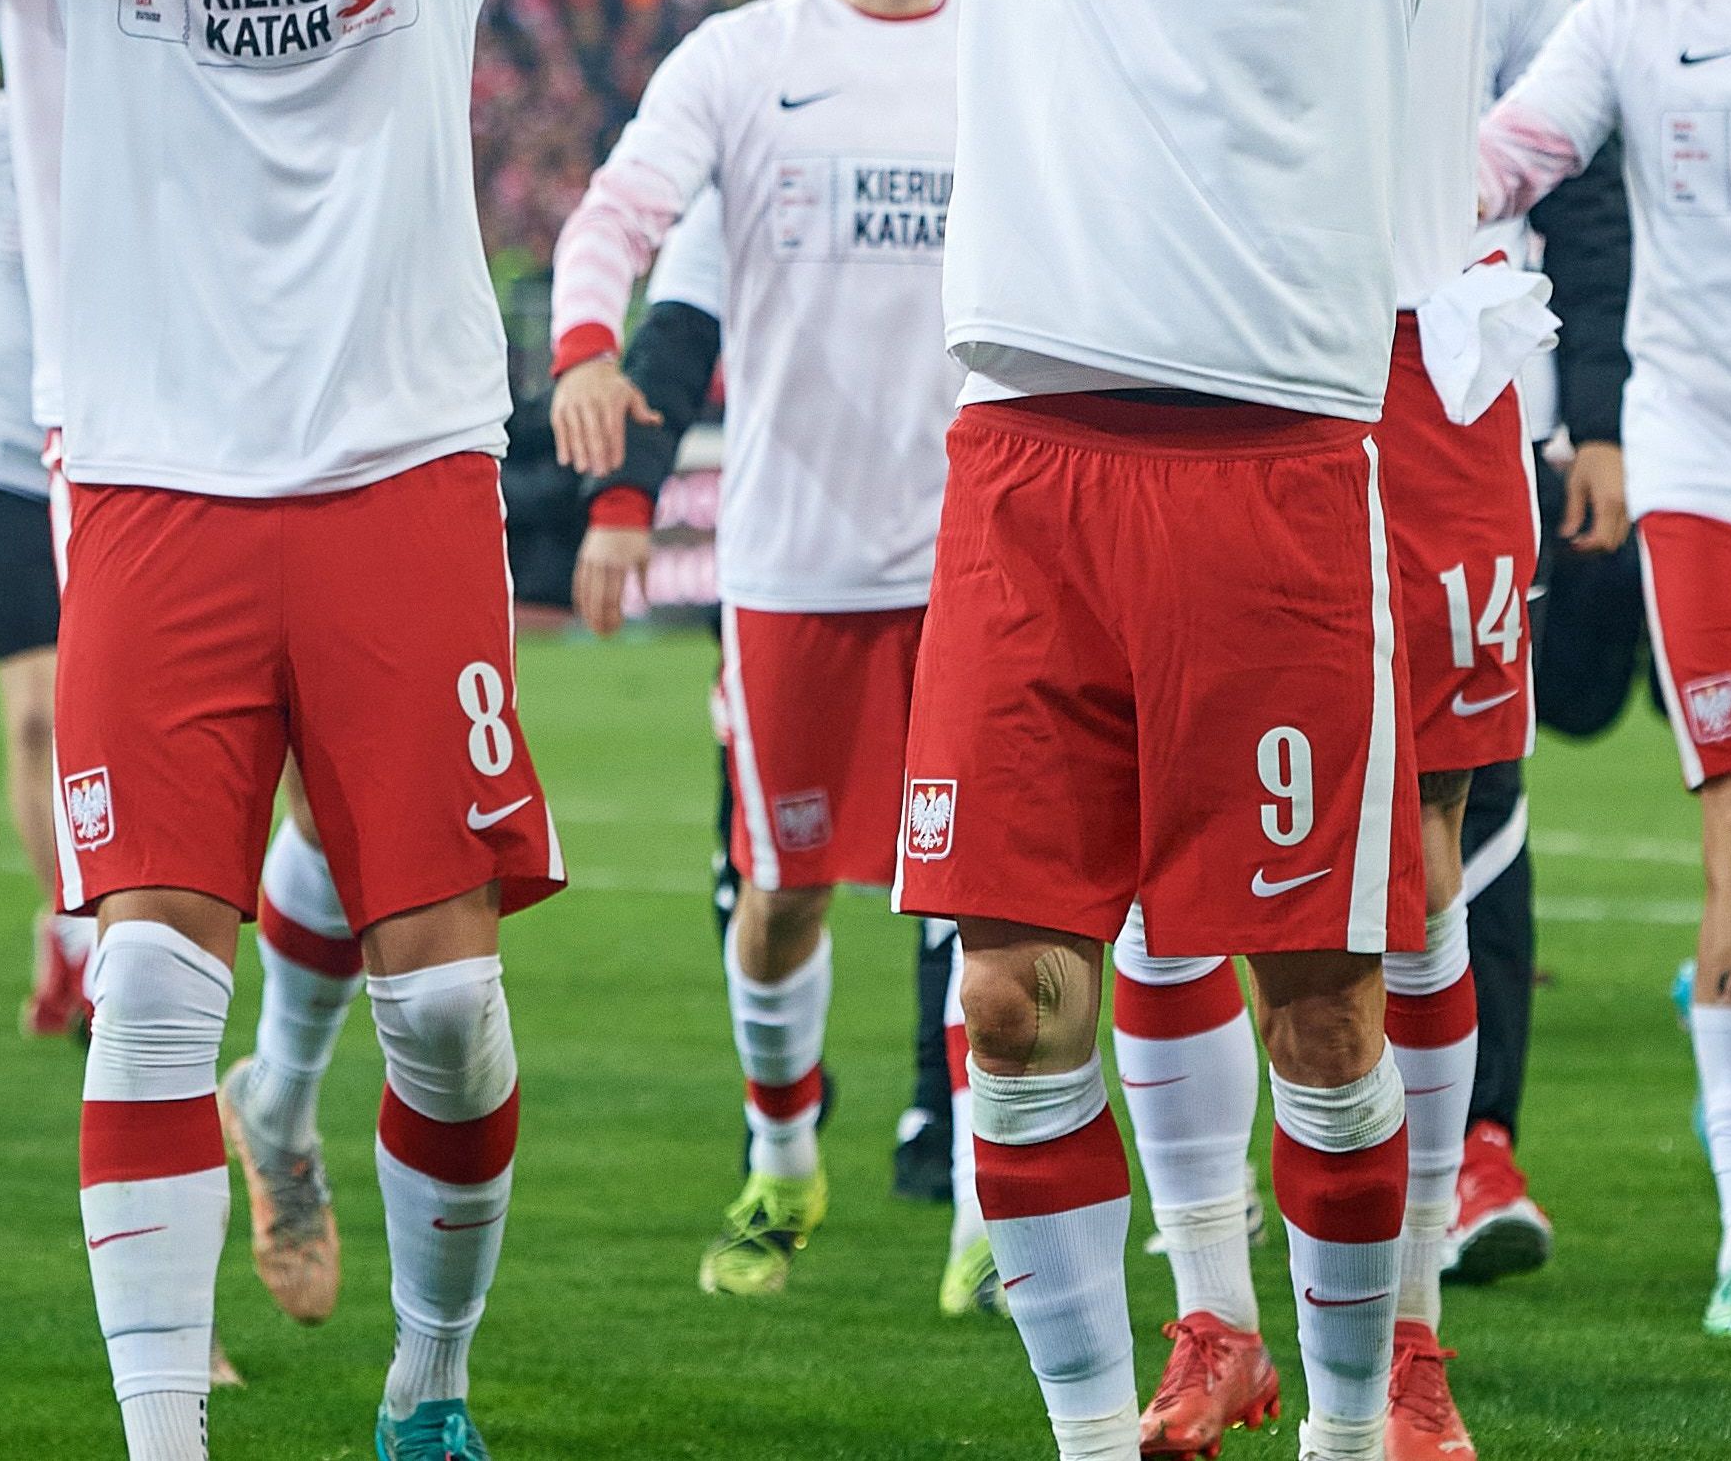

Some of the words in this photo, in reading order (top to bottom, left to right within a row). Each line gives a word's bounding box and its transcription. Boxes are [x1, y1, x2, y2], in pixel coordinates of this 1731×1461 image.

[205, 5, 332, 57] KATAR
[854, 169, 954, 205] KIERU
[1439, 556, 1522, 668] 14
[457, 661, 514, 777] 8
[1256, 726, 1314, 846] 9
